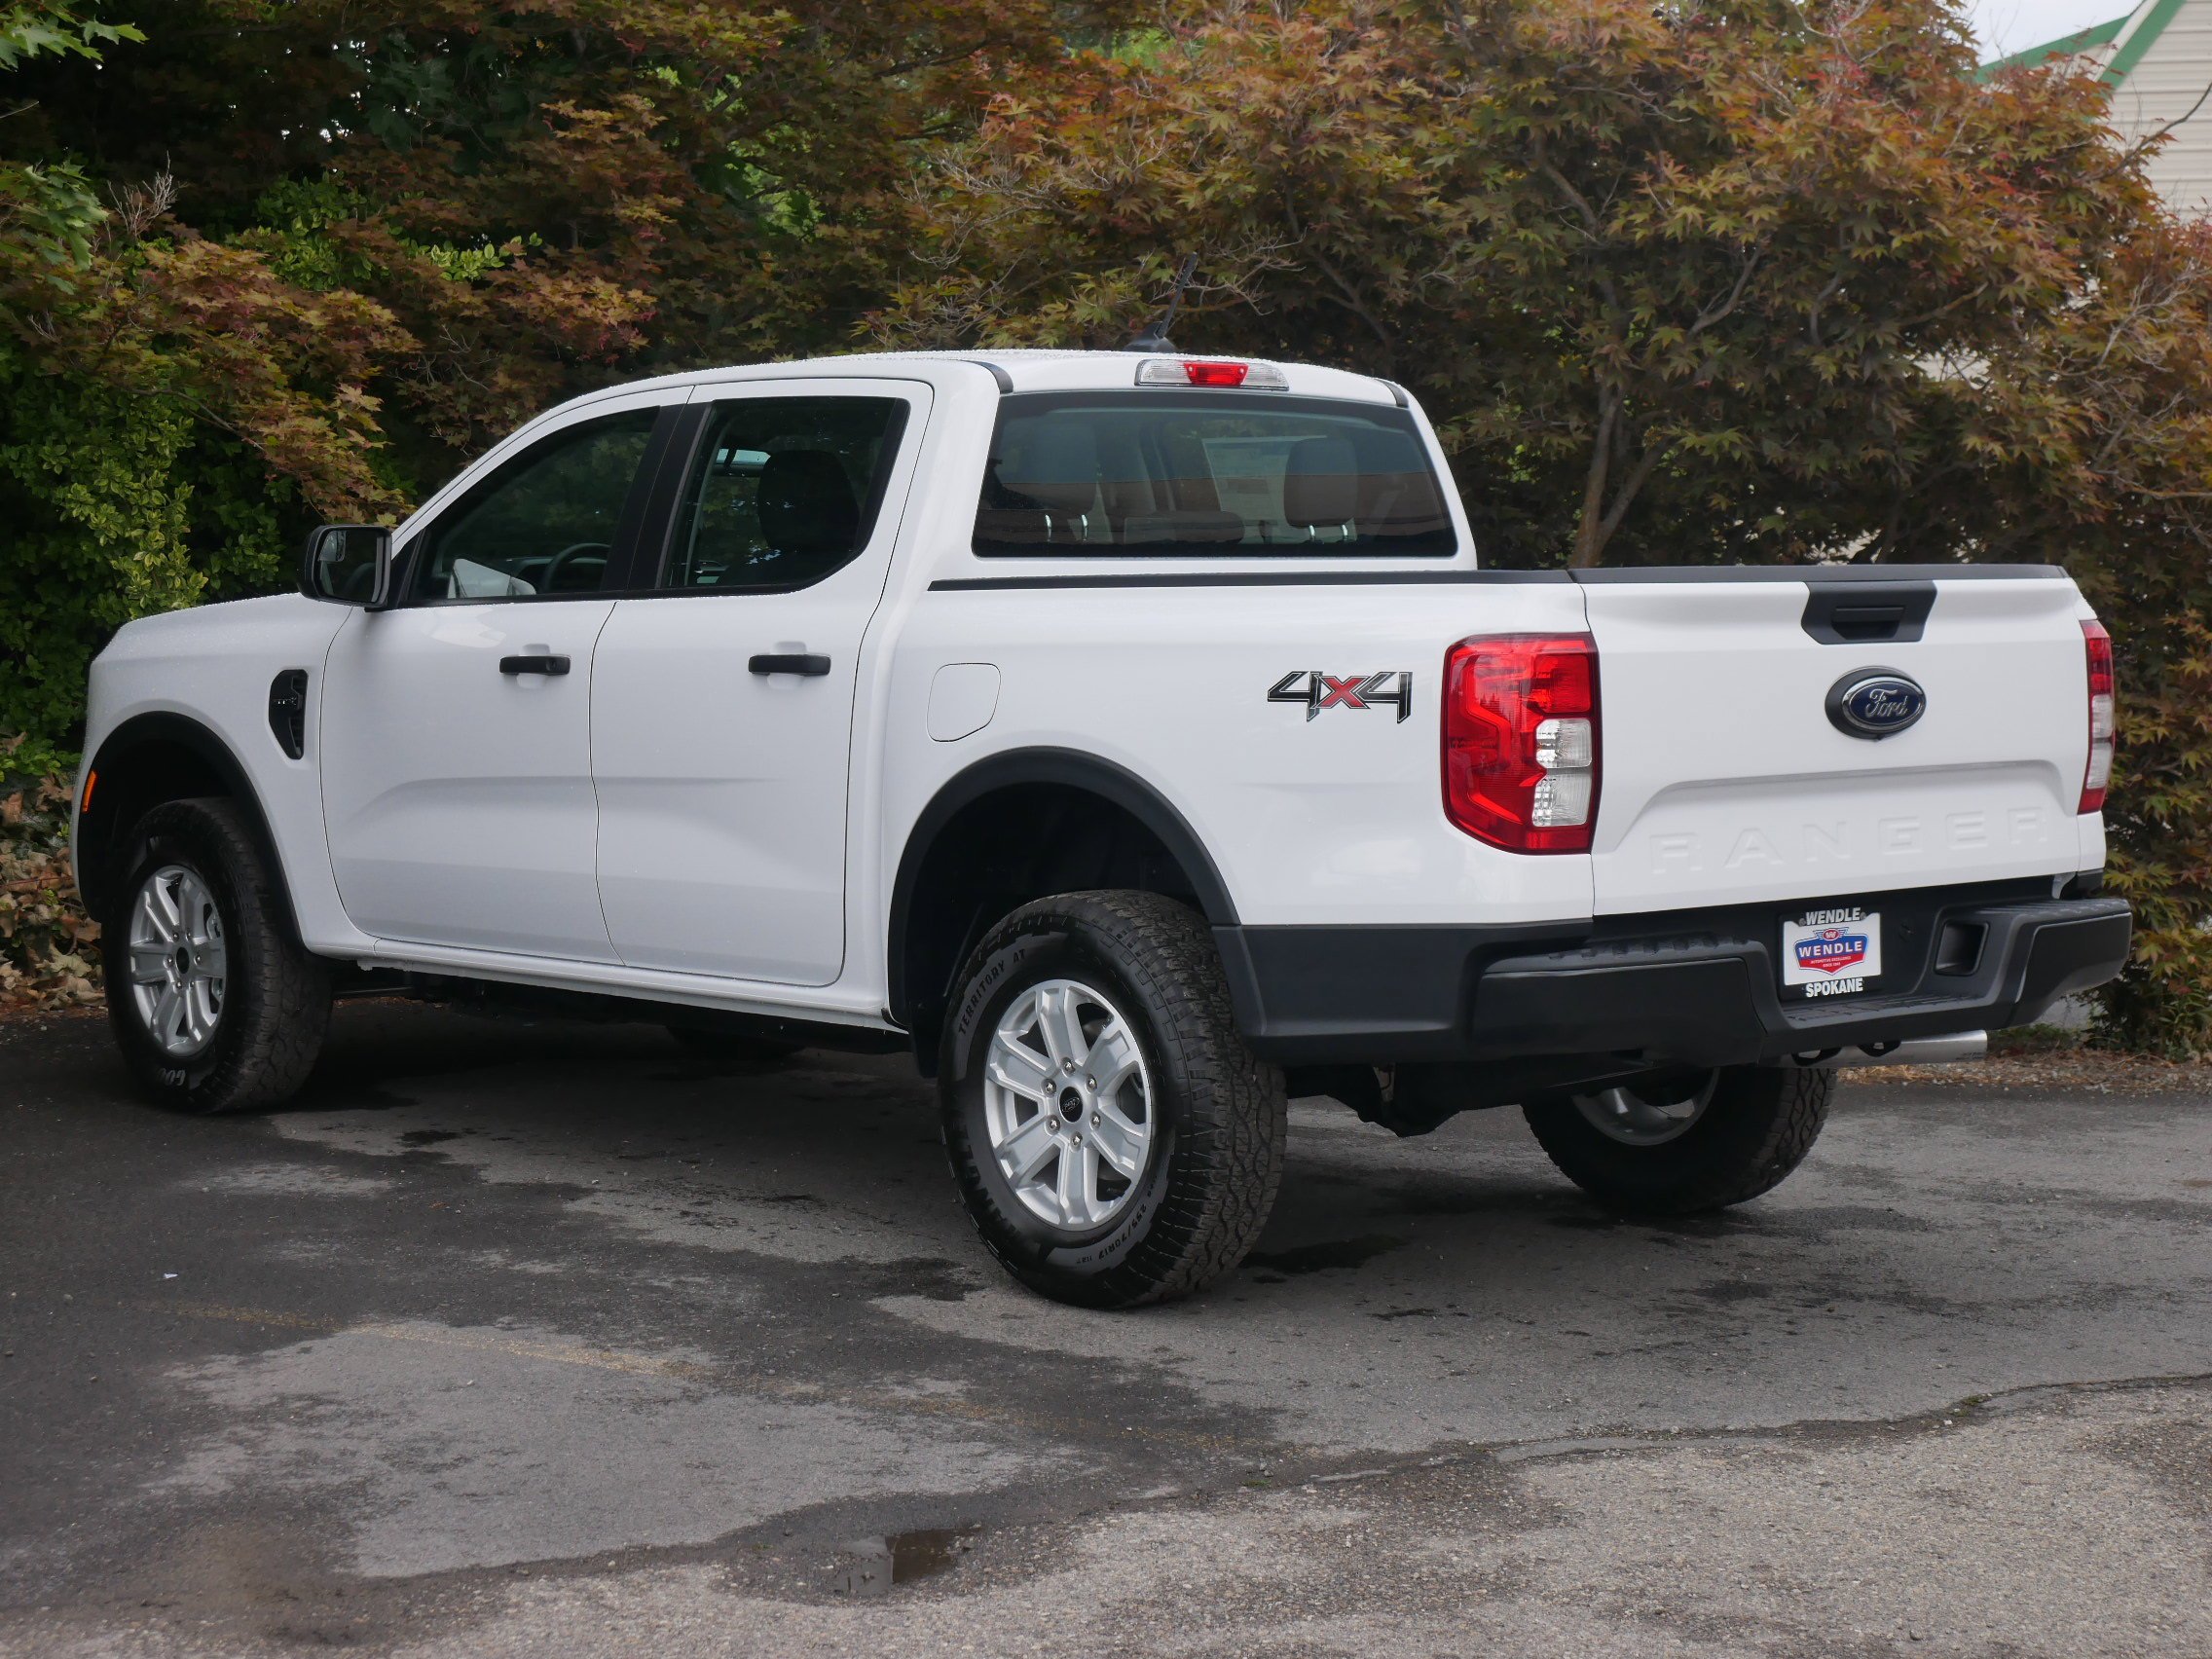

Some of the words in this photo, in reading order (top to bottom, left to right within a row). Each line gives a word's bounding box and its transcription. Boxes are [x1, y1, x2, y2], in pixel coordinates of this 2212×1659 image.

[1865, 688, 1908, 718] Ford
[1649, 806, 2048, 874] RANGER
[1805, 907, 1862, 926] WENDLE
[1798, 940, 1862, 958] WENDLE
[958, 960, 1005, 1035] TERRITORY
[1013, 948, 1026, 964] AT
[1805, 977, 1863, 998] SPOKANE
[1098, 1203, 1147, 1260] 255/70R17
